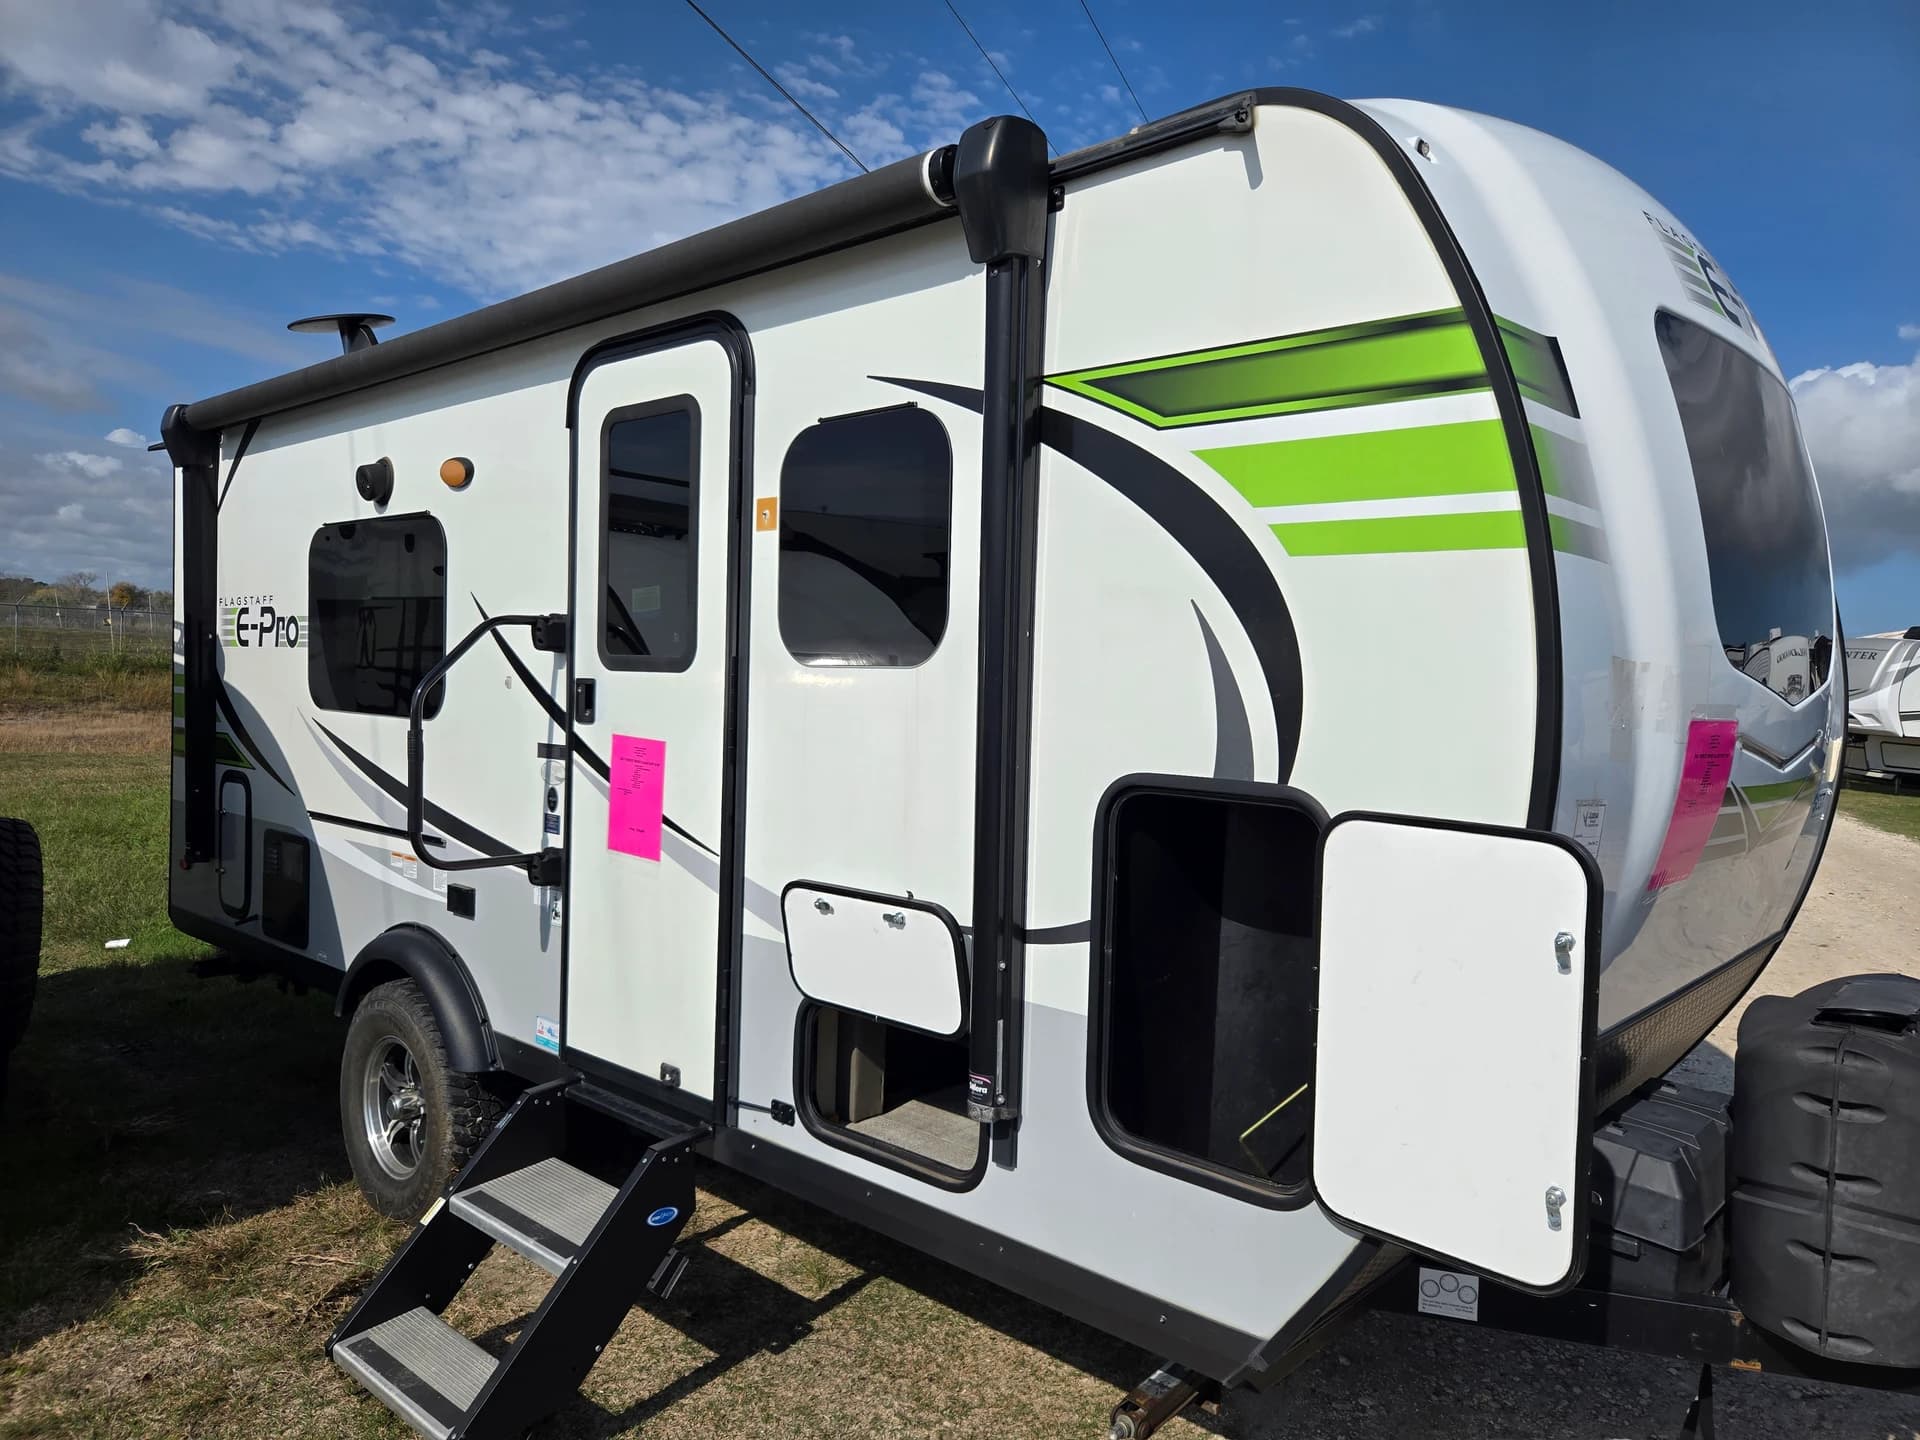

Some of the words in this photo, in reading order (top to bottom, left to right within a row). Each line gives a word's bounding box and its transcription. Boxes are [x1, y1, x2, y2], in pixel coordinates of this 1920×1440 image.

[219, 595, 273, 606] FLAGSTAFF
[237, 606, 299, 648] E-Pro
[1846, 651, 1877, 660] NTER
